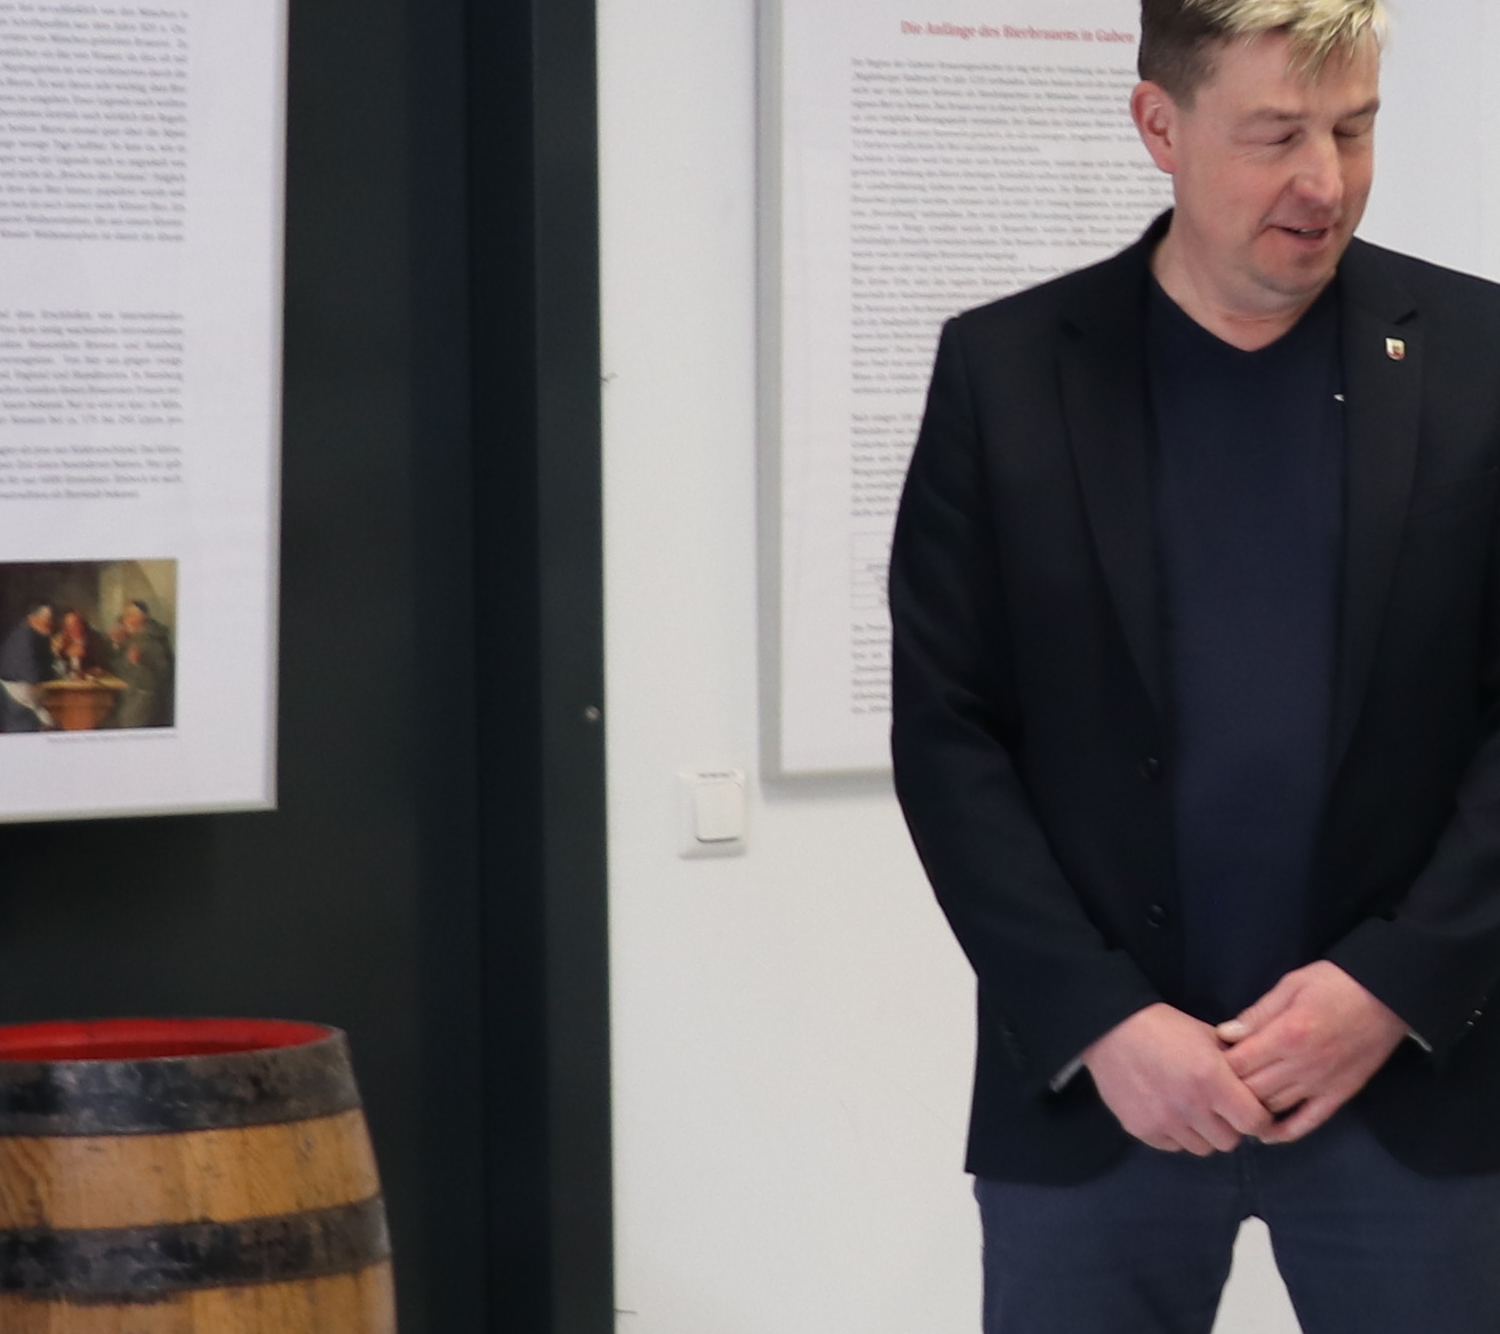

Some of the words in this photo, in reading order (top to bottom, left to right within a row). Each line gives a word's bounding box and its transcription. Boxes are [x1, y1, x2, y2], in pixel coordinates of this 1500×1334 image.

[900, 20, 922, 34] Die
[927, 21, 974, 39] Anfänge
[978, 23, 1000, 37] des
[1002, 24, 1079, 40] Bierbrauens
[1081, 27, 1093, 41] in
[1095, 28, 1135, 43] Guben
